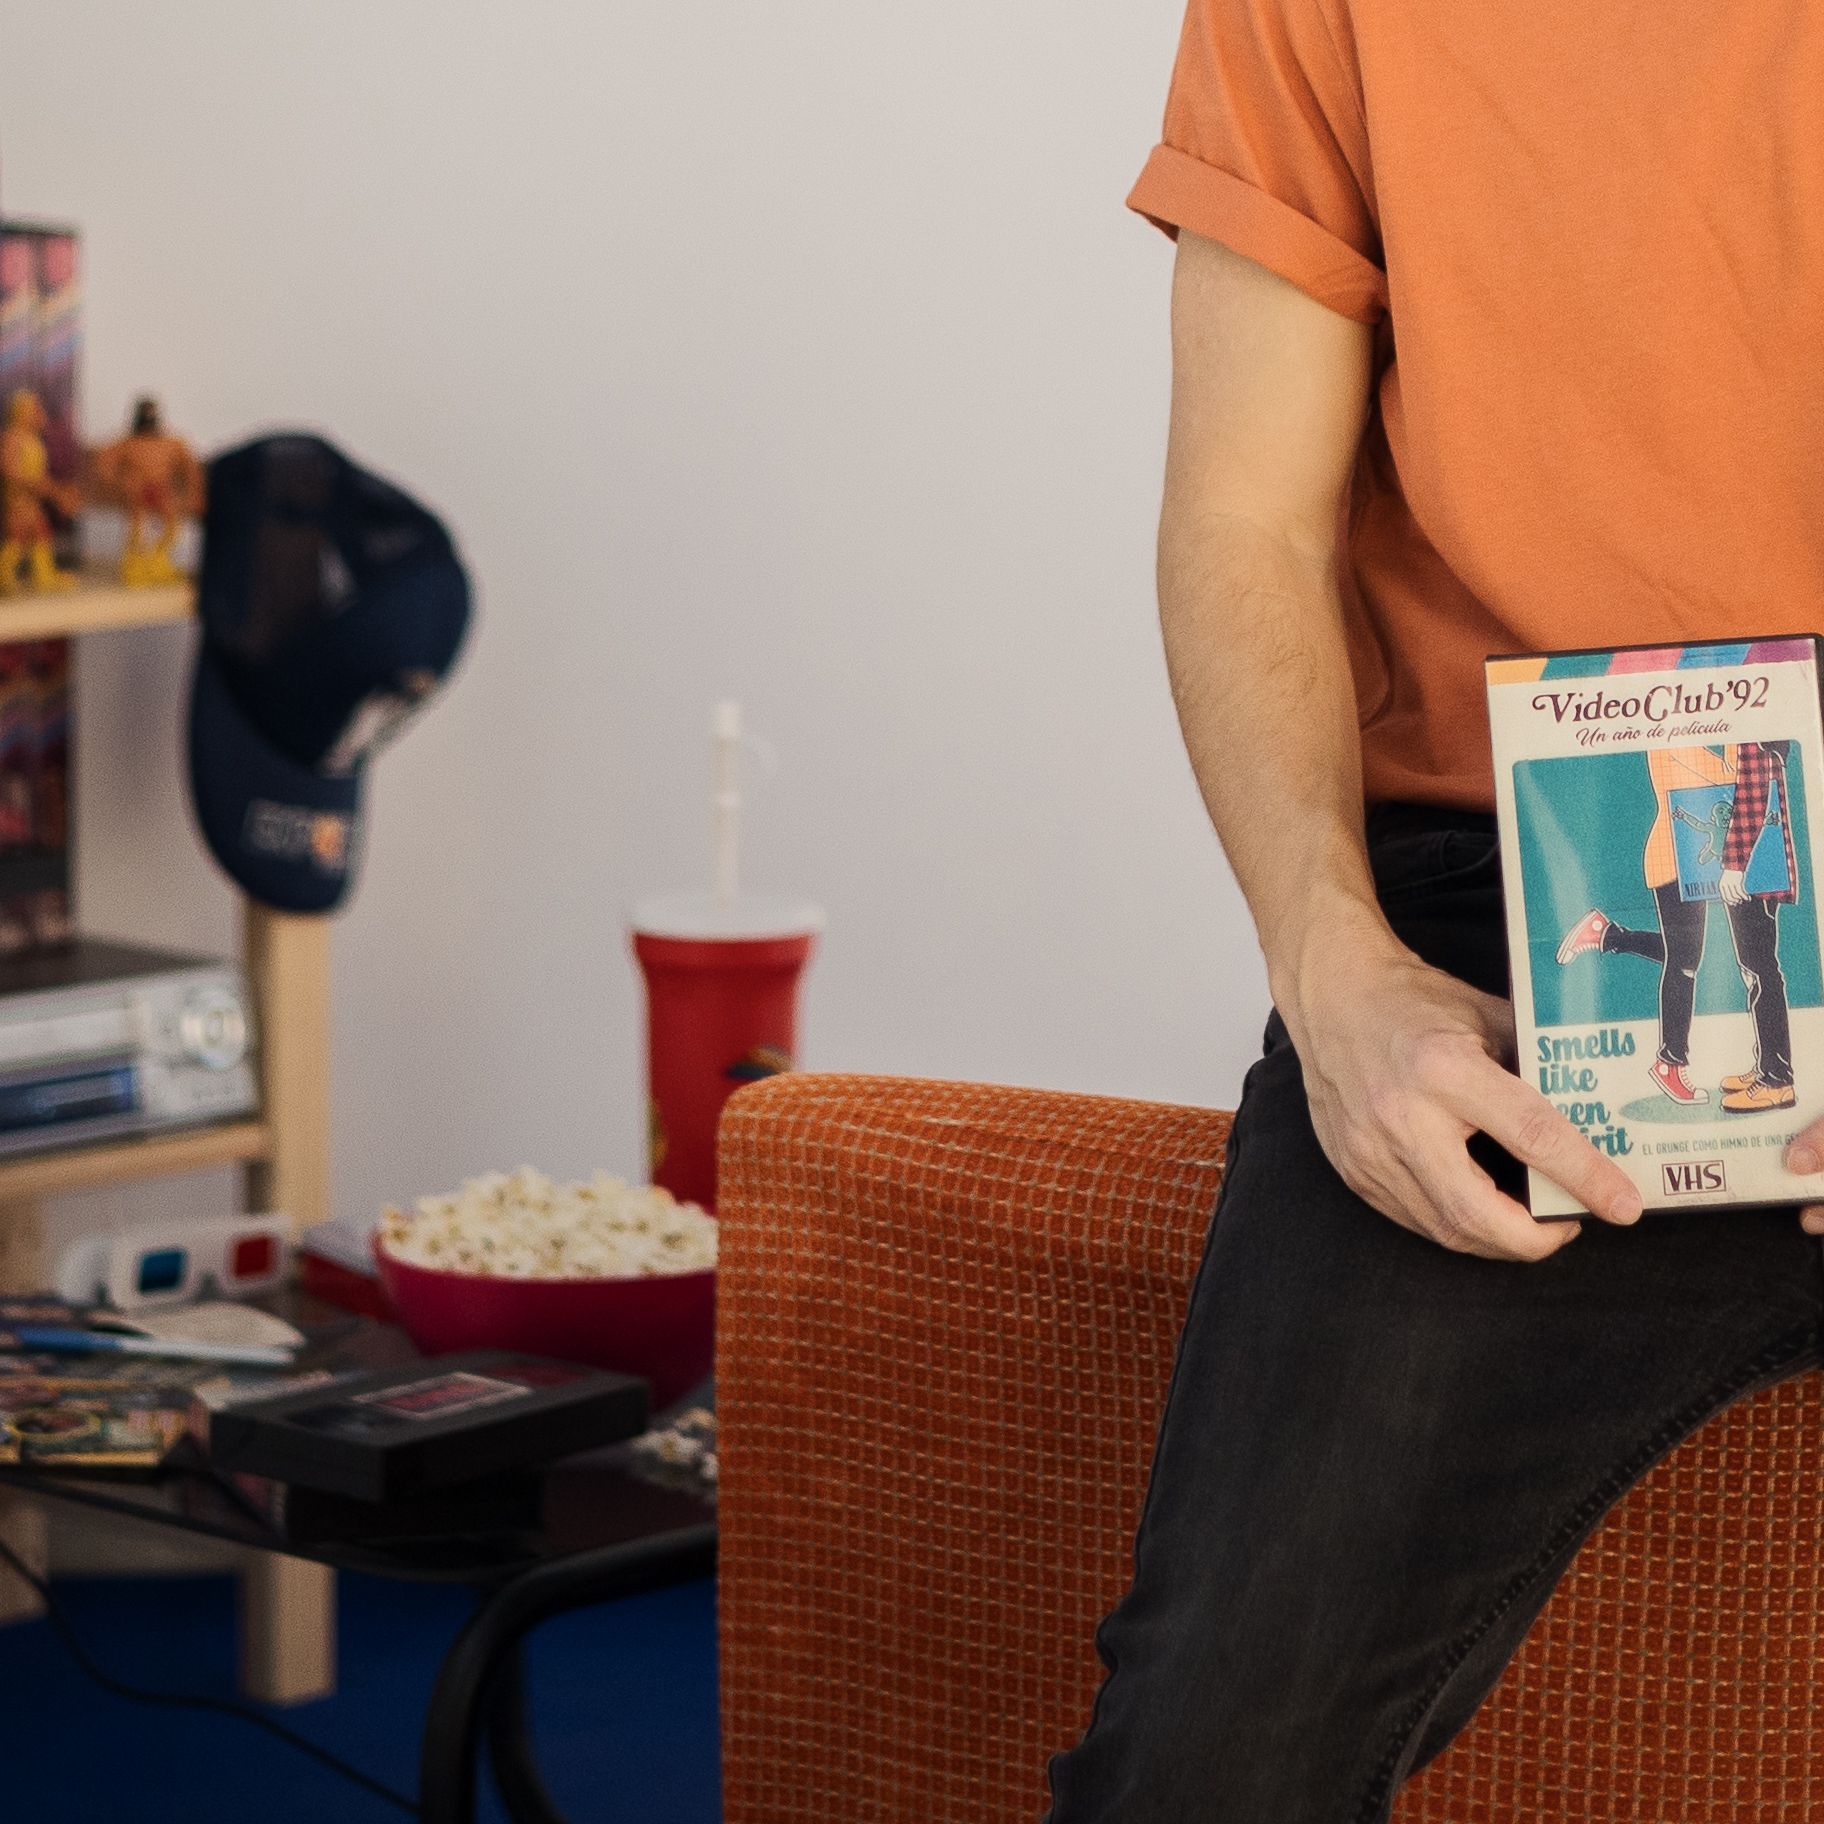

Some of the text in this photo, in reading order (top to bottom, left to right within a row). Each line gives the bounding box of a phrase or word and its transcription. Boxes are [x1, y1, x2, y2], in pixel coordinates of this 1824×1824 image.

[1575, 727, 1606, 747] Un
[1612, 725, 1641, 742] año
[1647, 722, 1665, 738] de
[1539, 1063, 1598, 1095] like
[1642, 1144, 1654, 1156] EL
[1692, 1139, 1719, 1151] COMO
[1721, 1137, 1749, 1150] HIMNO
[1750, 1136, 1762, 1147] DE
[1764, 1135, 1782, 1146] UNA
[1665, 1163, 1723, 1192] VHS
